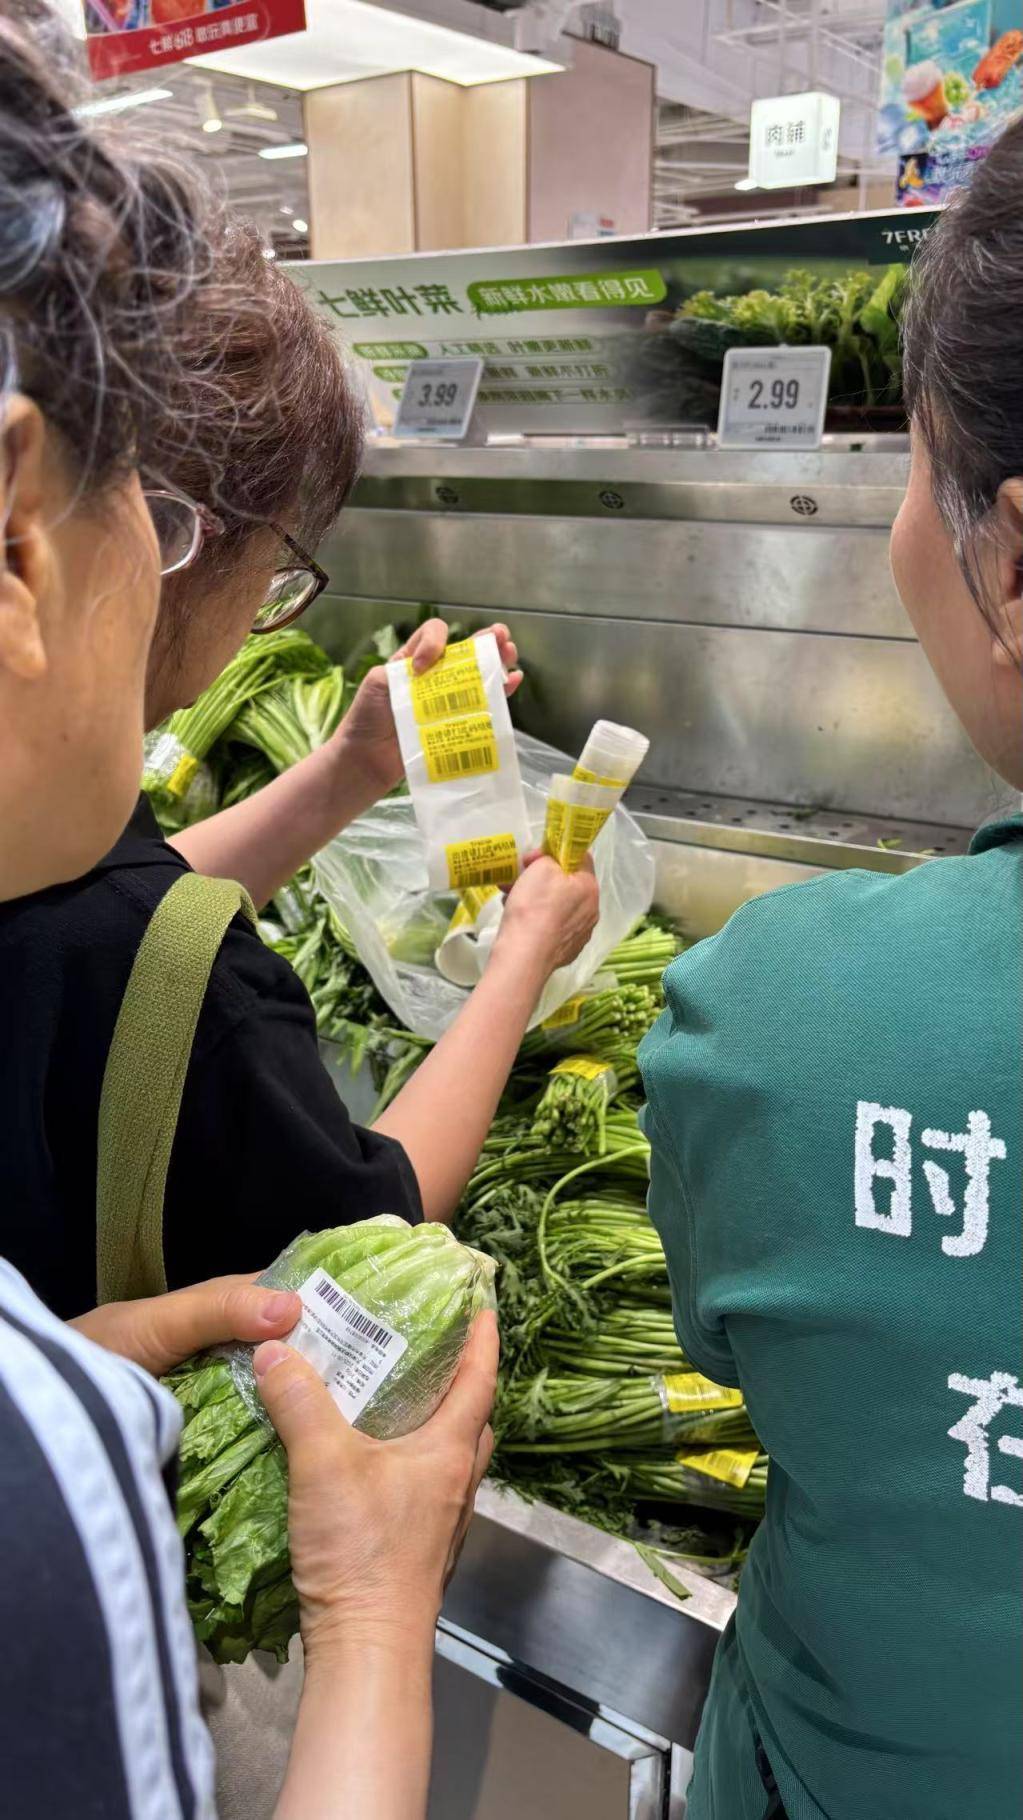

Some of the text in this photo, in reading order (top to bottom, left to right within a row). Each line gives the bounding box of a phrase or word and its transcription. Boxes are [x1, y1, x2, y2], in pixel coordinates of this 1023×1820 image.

[319, 284, 463, 318] 七鲜叶菜
[478, 277, 655, 306] 新鲜水嫩看得见
[418, 383, 458, 408] 3.99
[748, 379, 799, 409] 2.99
[854, 1100, 1007, 1257] 时
